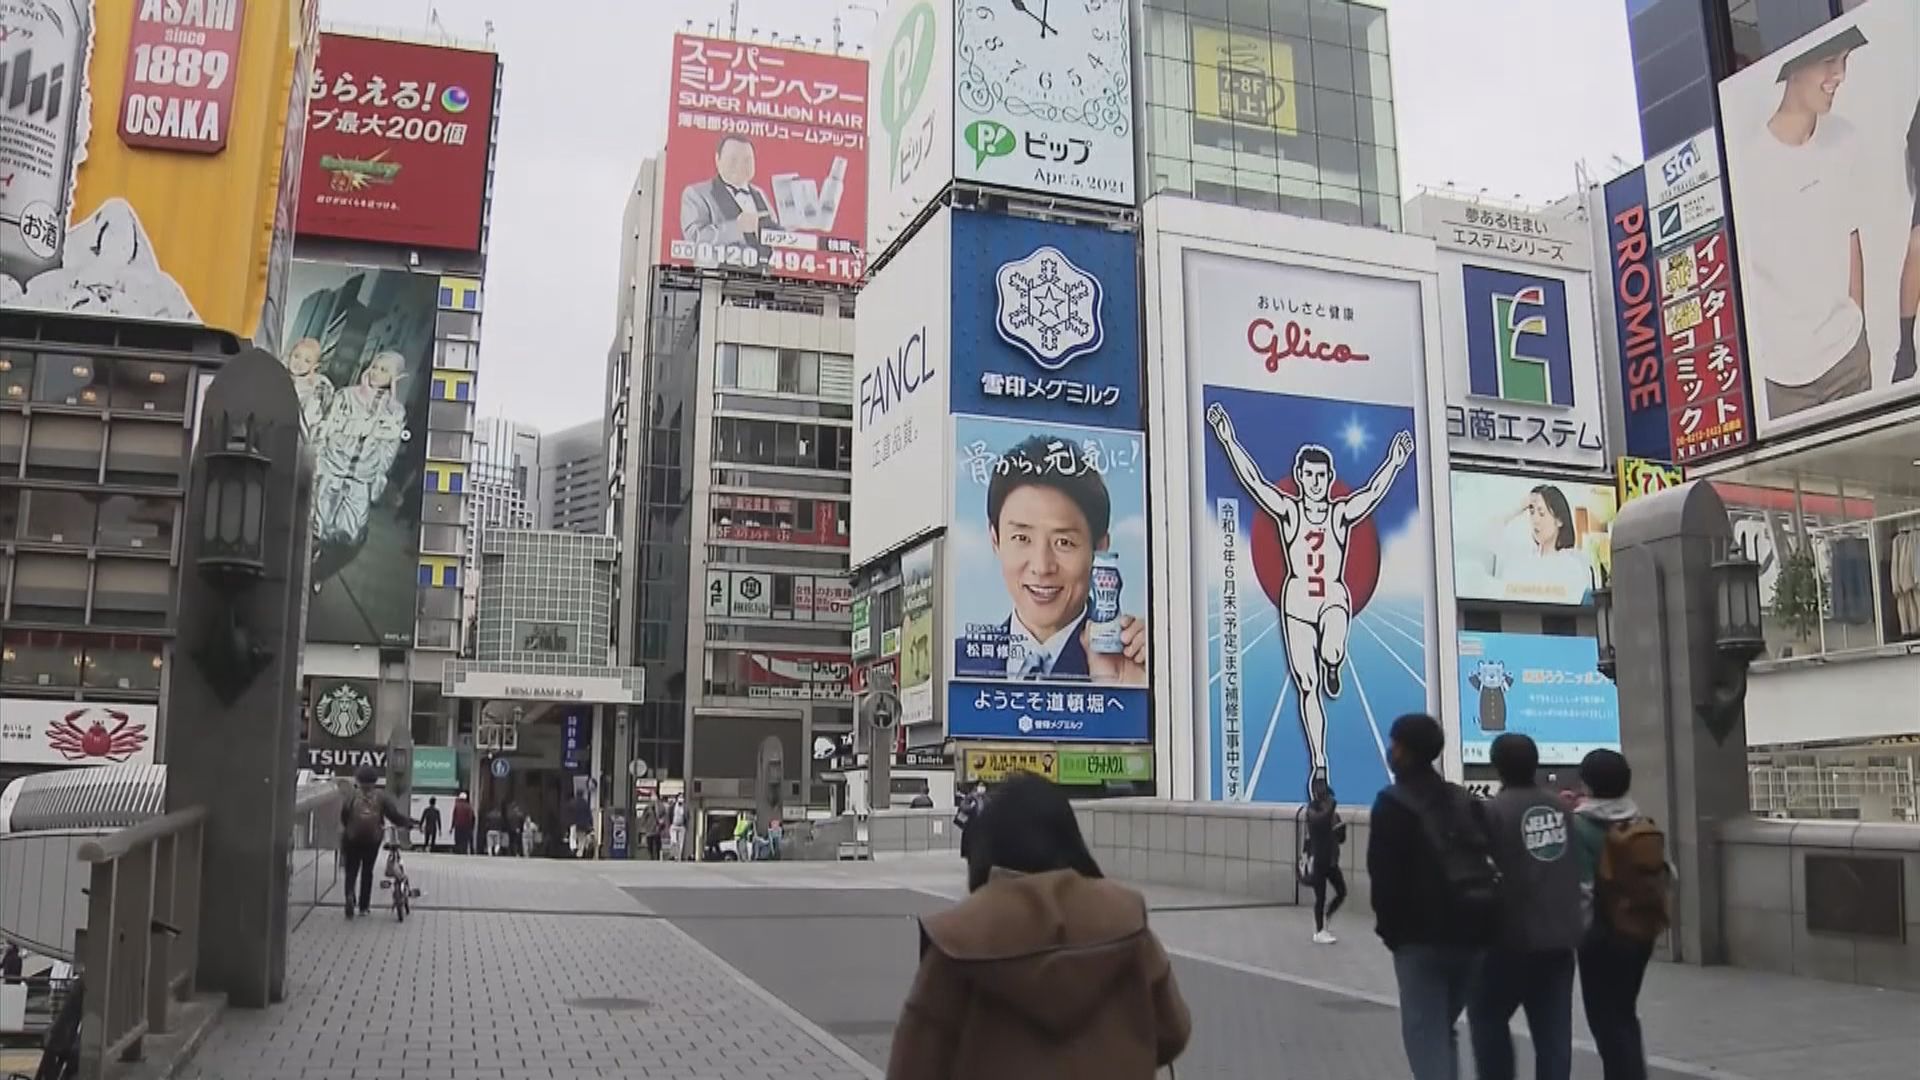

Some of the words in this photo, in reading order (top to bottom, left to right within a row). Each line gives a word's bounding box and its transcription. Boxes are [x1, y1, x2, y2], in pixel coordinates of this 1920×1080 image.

[140, 0, 236, 31] ASAHI
[164, 27, 206, 46] since
[681, 38, 784, 72] スーパー
[134, 43, 229, 89] 1889
[680, 63, 864, 105] ミリオンヘアー
[1039, 71, 1053, 90] 6
[0, 48, 64, 122] hi
[126, 94, 218, 141] OSAKA
[678, 91, 741, 112] SUPER
[746, 100, 814, 122] MILLION
[818, 109, 864, 130] HAIR
[1025, 130, 1093, 165] ピップ
[23, 214, 58, 250] お酒
[1465, 207, 1548, 234] 夢ある住まい
[1453, 229, 1564, 261] エステムシリーズ
[1257, 295, 1354, 321] おいしさと健康
[1614, 204, 1662, 412] PROMISE
[1247, 317, 1370, 373] Glico
[1697, 234, 1738, 424] インターネット
[860, 326, 935, 432] FANCL
[981, 371, 1120, 406] 雪印メグミルク
[1671, 330, 1703, 435] コミック
[1447, 405, 1603, 450] 日商エステム
[961, 438, 1140, 485] 骨から、元気に!
[1304, 527, 1326, 598] グリコ
[974, 689, 1125, 714] ようこそ道頓堀へ
[308, 749, 388, 767] TSUTAY
[1525, 811, 1565, 834] JELLY
